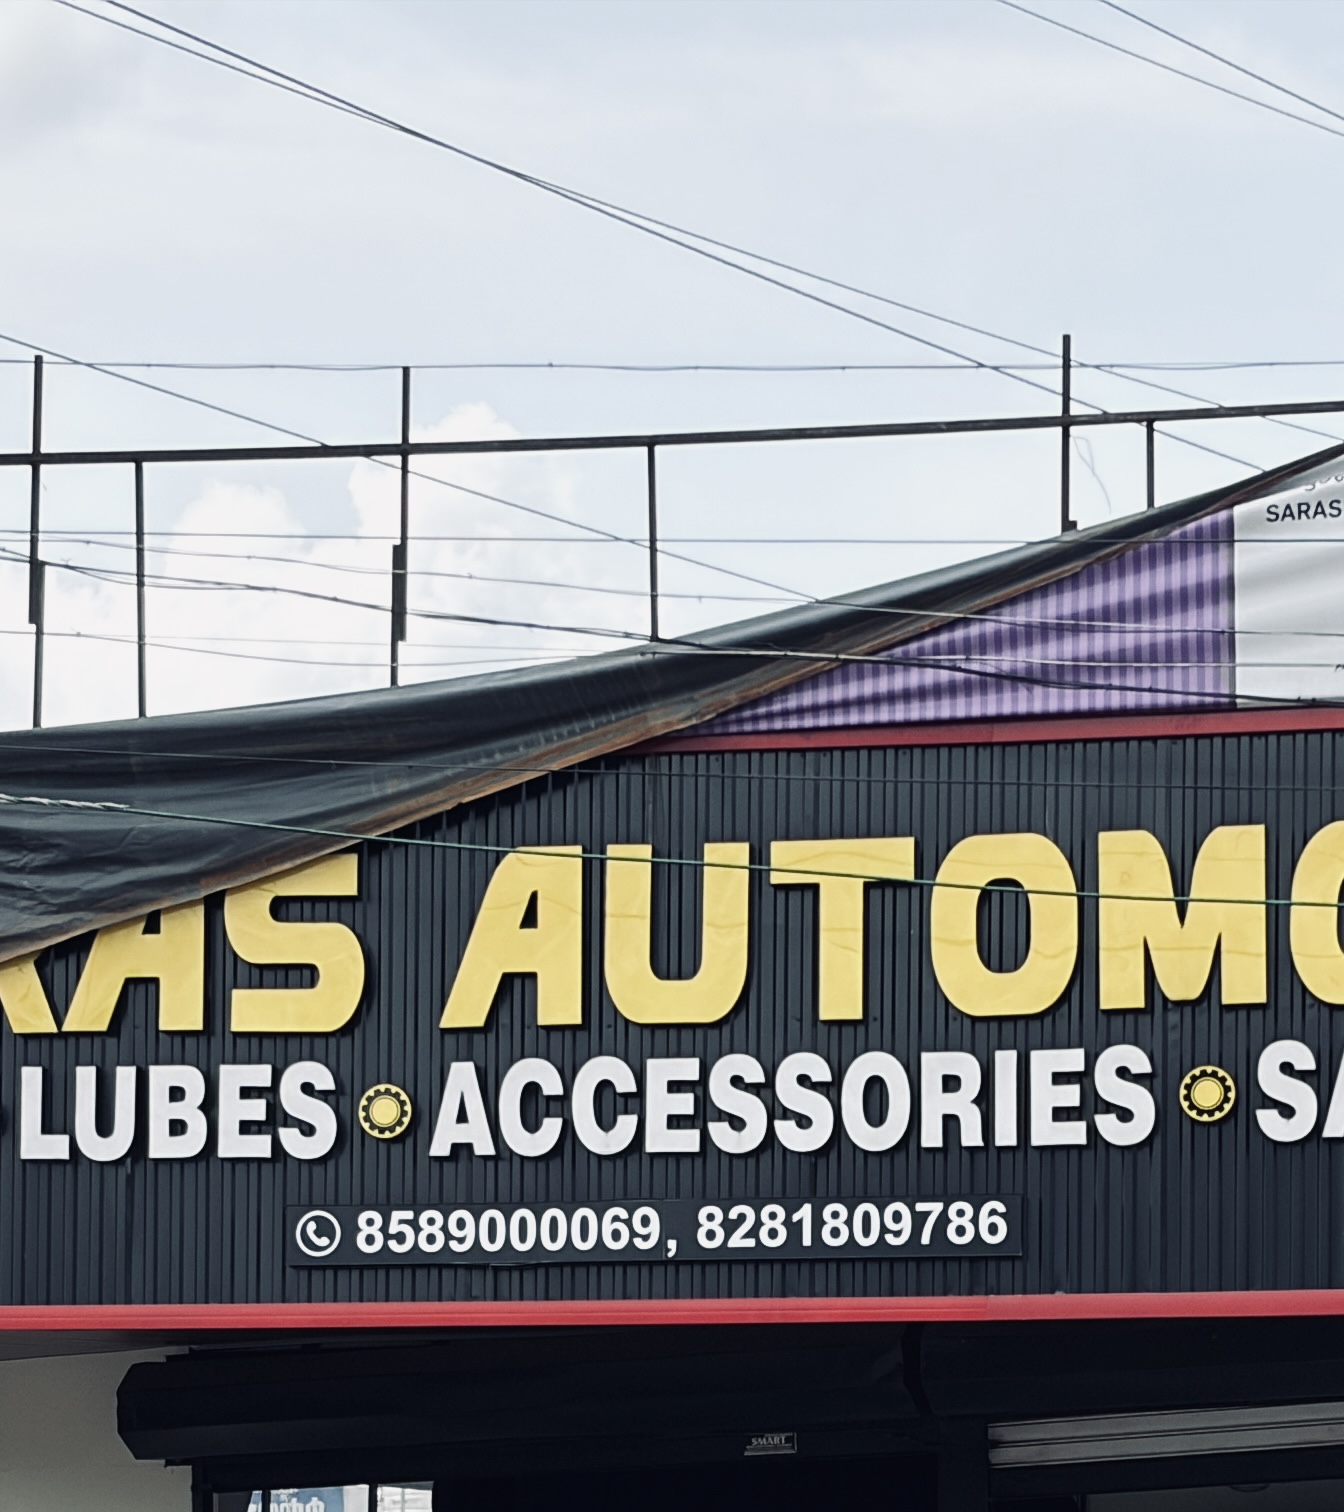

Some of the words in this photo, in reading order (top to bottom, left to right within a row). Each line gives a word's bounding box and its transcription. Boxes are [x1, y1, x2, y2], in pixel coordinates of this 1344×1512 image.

[1266, 499, 1342, 522] SARAS
[19, 1061, 339, 1160] LUBES
[428, 1045, 1157, 1158] ACCESSORIES
[356, 1206, 678, 1259] 8589000069,
[696, 1200, 1009, 1250] 8281809786
